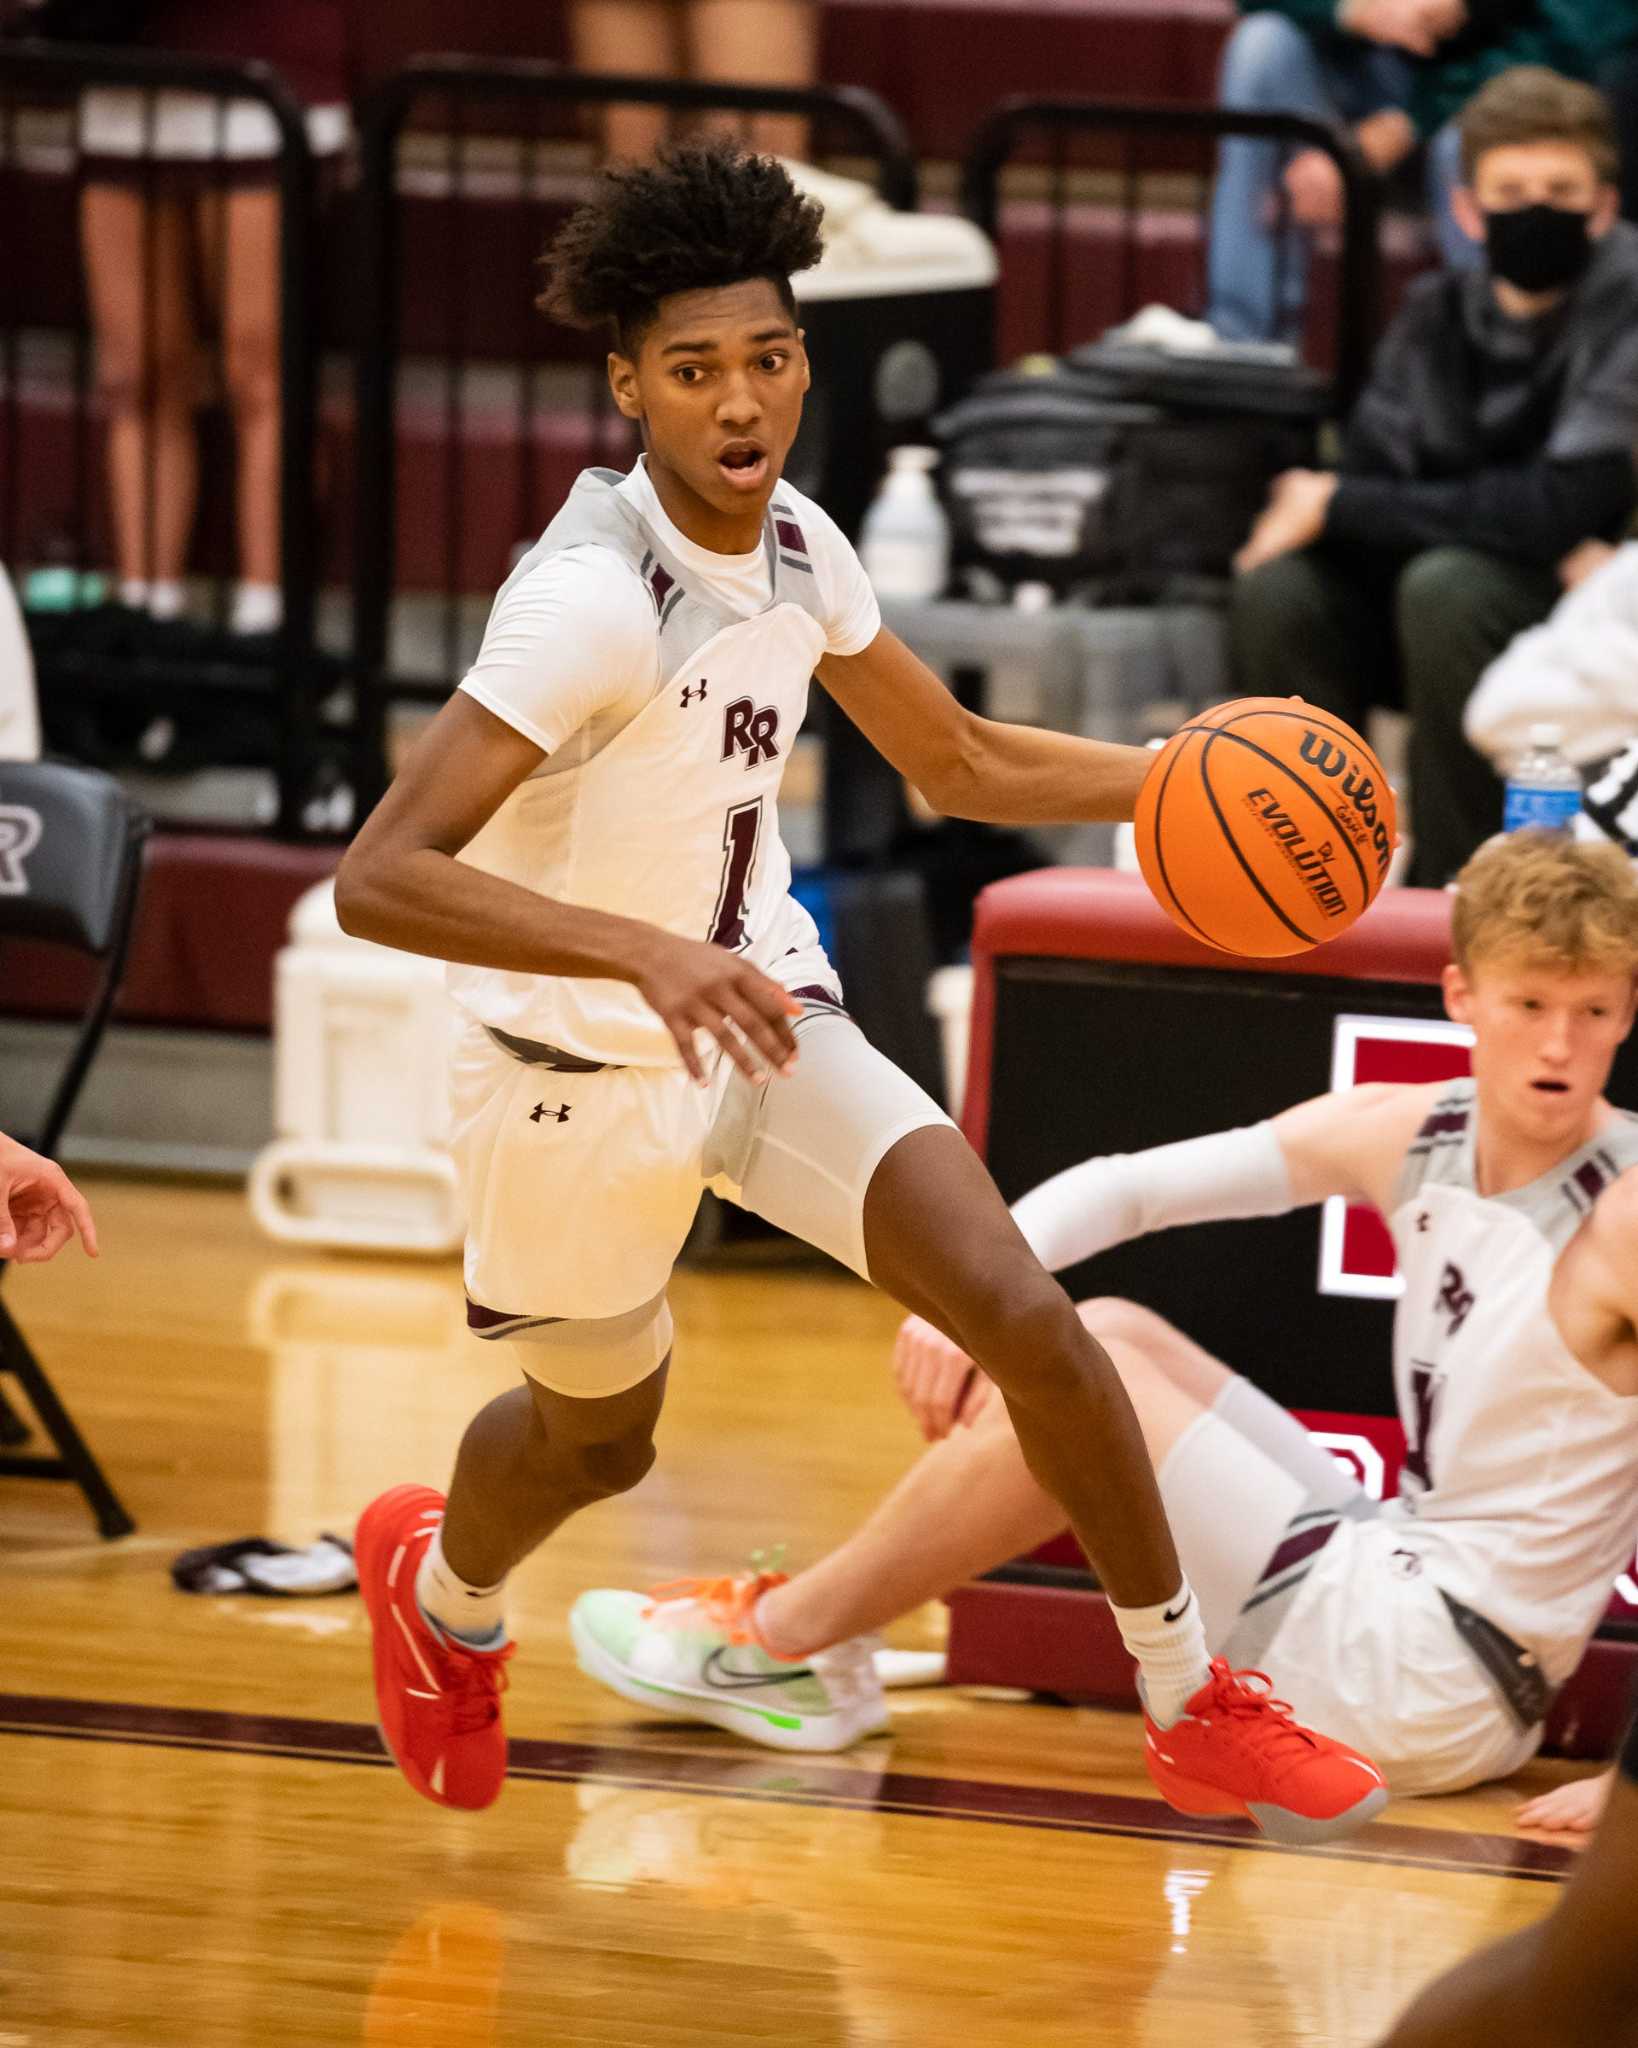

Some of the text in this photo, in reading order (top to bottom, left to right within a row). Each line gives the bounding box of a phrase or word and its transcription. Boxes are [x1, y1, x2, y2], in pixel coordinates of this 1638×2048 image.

[720, 695, 780, 771] RR
[706, 795, 763, 955] 1
[1247, 787, 1347, 918] EVOLUTION
